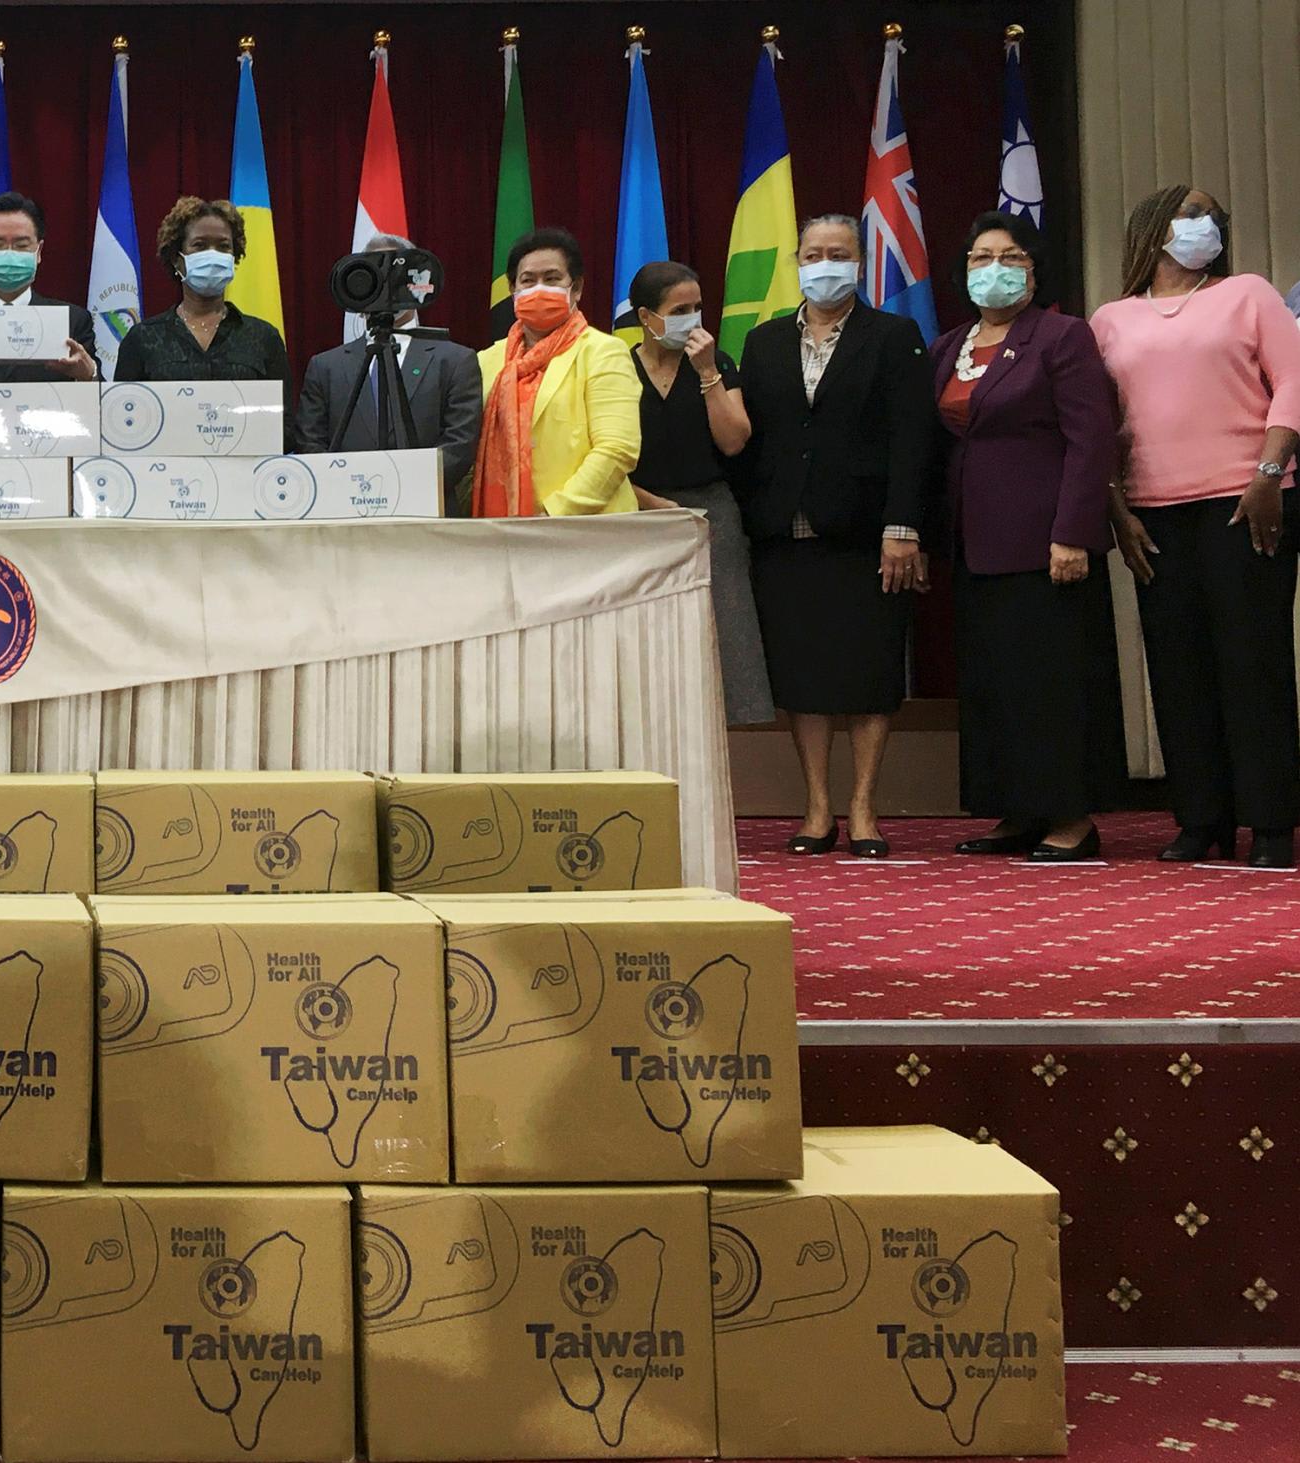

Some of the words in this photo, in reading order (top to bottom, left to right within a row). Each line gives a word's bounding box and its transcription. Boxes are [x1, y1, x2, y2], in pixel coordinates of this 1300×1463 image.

[197, 425, 233, 433] Taiwan
[169, 500, 206, 509] Taiwan
[350, 496, 387, 504] Taiwan
[231, 809, 275, 819] Health
[532, 809, 577, 820] Health
[232, 821, 251, 831] for
[255, 821, 275, 832] All
[533, 821, 553, 832] for
[557, 822, 578, 833] All
[267, 953, 321, 966] Health
[616, 953, 670, 966] Health
[268, 968, 292, 981] for
[297, 968, 322, 982] All
[617, 967, 641, 981] for
[646, 968, 671, 981] All
[261, 1047, 418, 1082] Taiwan
[612, 1047, 771, 1081] Taiwan
[20, 1084, 54, 1099] Help
[347, 1088, 374, 1101] Can
[382, 1087, 417, 1102] Help
[699, 1087, 727, 1101] Can
[735, 1087, 771, 1102] Help
[171, 1228, 226, 1242] Health
[532, 1227, 586, 1240] Health
[882, 1229, 937, 1242] Health
[171, 1243, 196, 1257] for
[201, 1244, 226, 1258] All
[532, 1242, 557, 1256] for
[561, 1242, 587, 1256] All
[883, 1244, 908, 1257] for
[913, 1244, 938, 1258] All
[163, 1325, 323, 1362] Taiwan
[526, 1323, 685, 1359] Taiwan
[877, 1324, 1038, 1359] Taiwan
[250, 1367, 277, 1382] Can
[285, 1368, 321, 1383] Help
[613, 1365, 640, 1379] Can
[648, 1364, 684, 1379] Help
[965, 1365, 992, 1379] Can
[1001, 1365, 1037, 1380] Help
